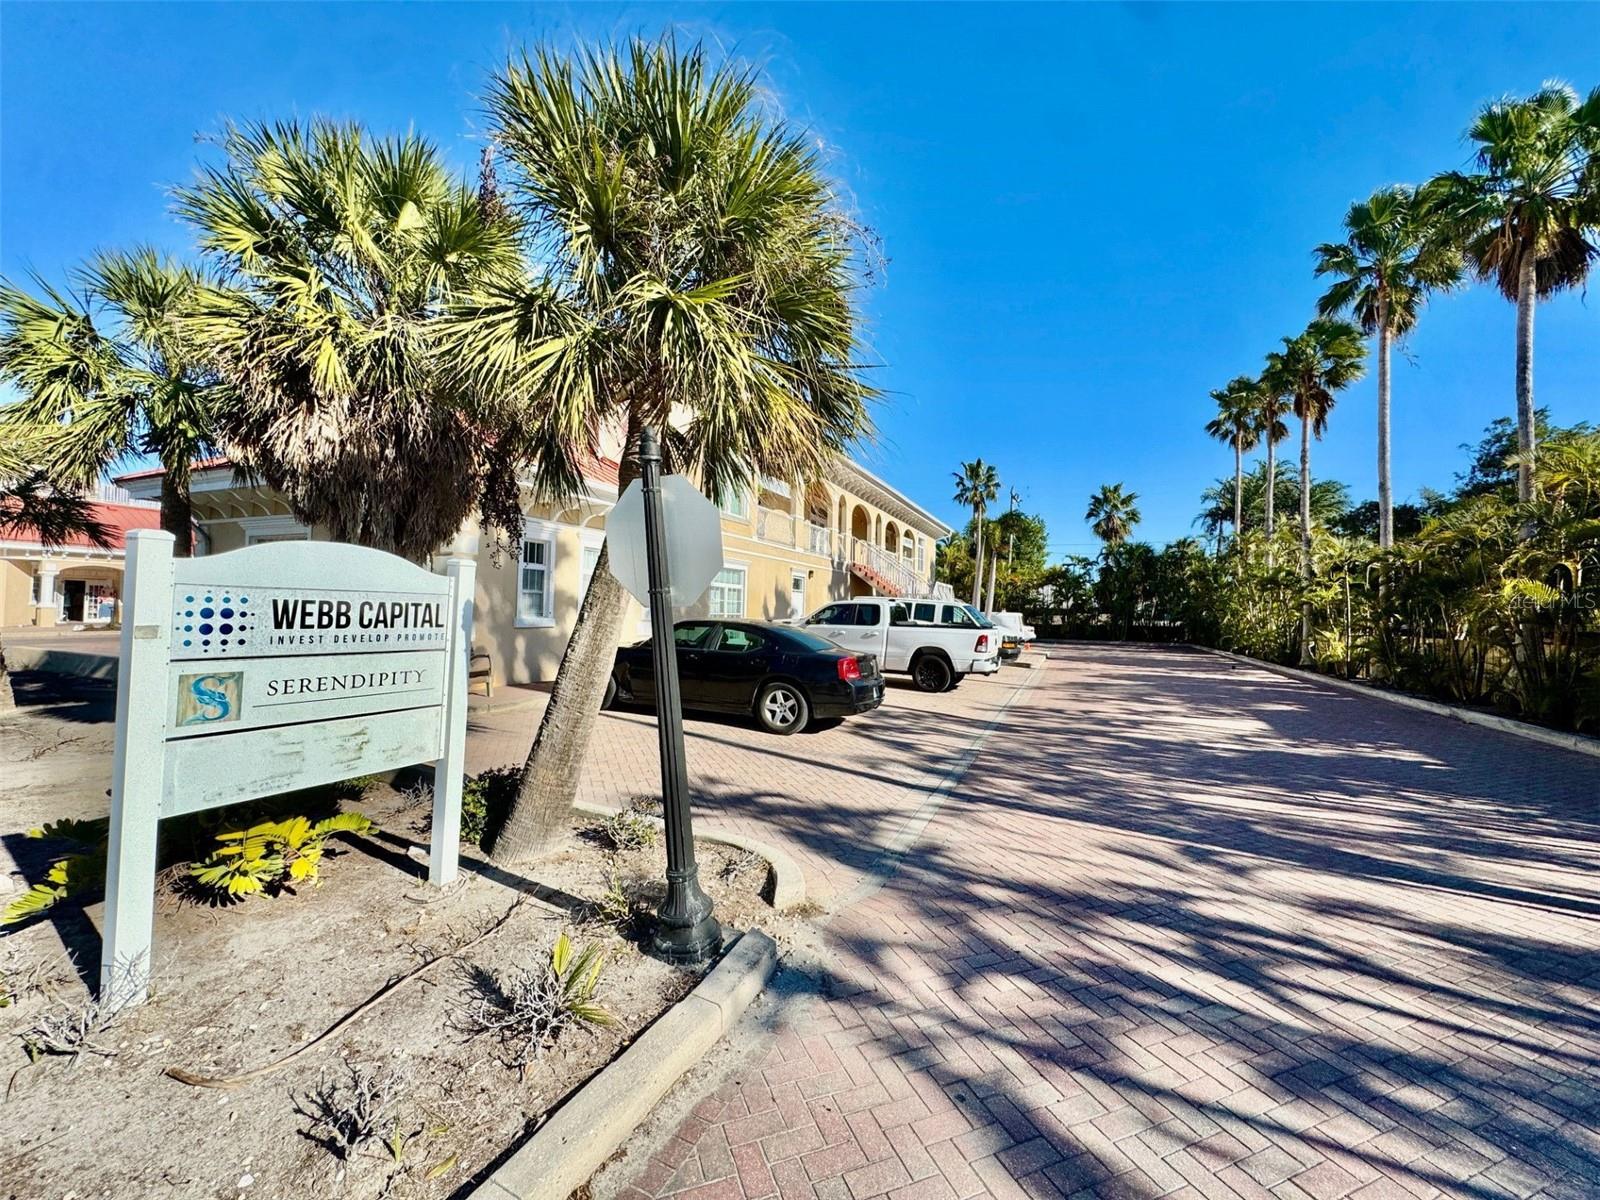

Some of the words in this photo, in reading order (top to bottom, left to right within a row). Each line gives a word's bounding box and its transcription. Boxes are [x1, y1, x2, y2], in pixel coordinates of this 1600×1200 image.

[272, 599, 351, 630] WEBB
[358, 601, 445, 629] CAPITAL
[269, 634, 325, 646] INVEST
[333, 634, 390, 645] DEVELOP
[396, 632, 446, 642] PROMOTE
[266, 668, 428, 697] SERENDIPITY
